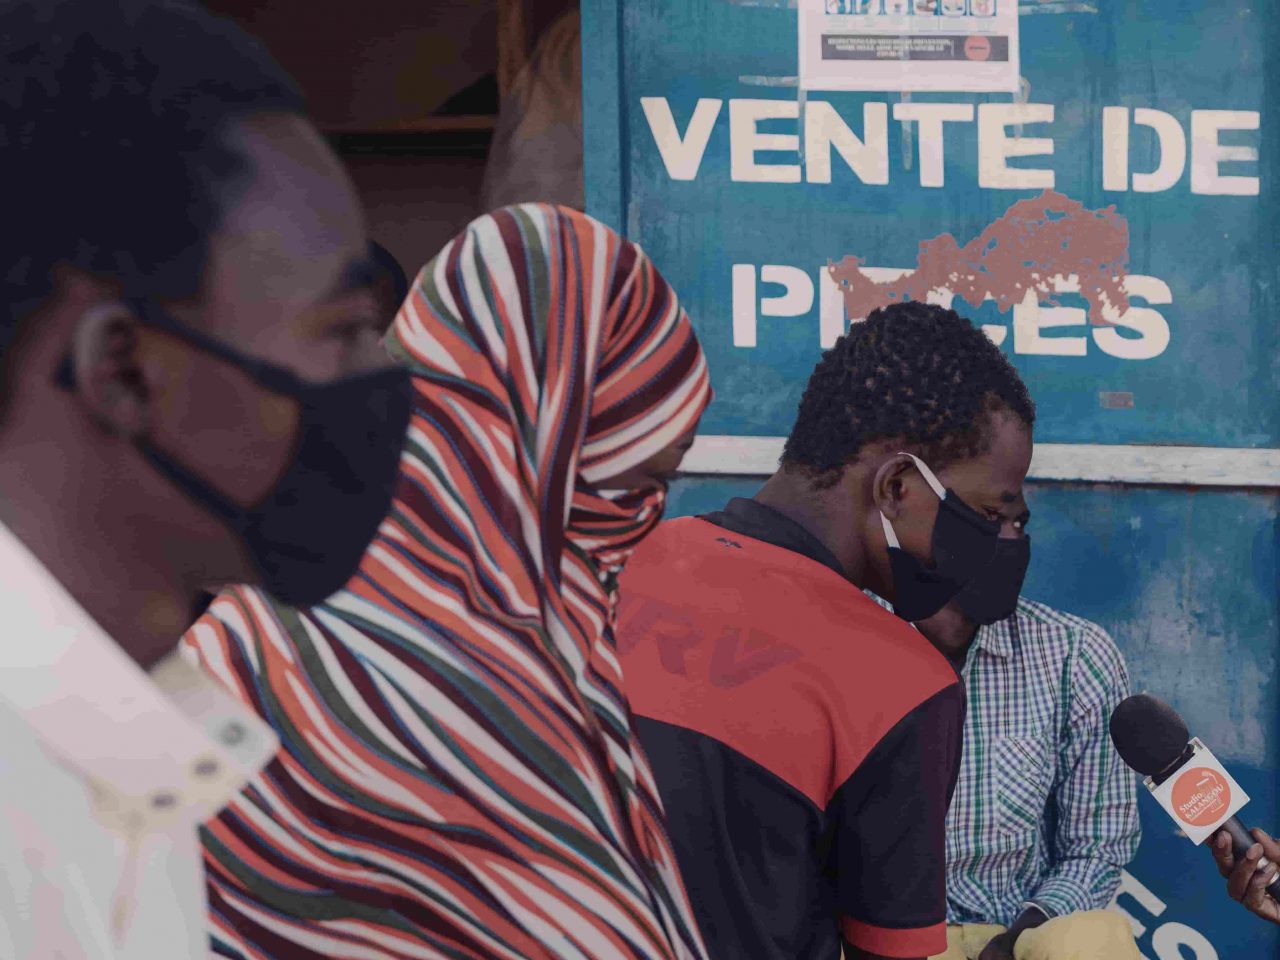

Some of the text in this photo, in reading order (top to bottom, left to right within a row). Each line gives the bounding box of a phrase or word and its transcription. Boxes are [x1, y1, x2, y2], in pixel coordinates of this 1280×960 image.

[641, 97, 1260, 196] VENTE DE
[1179, 791, 1205, 813] Studio
